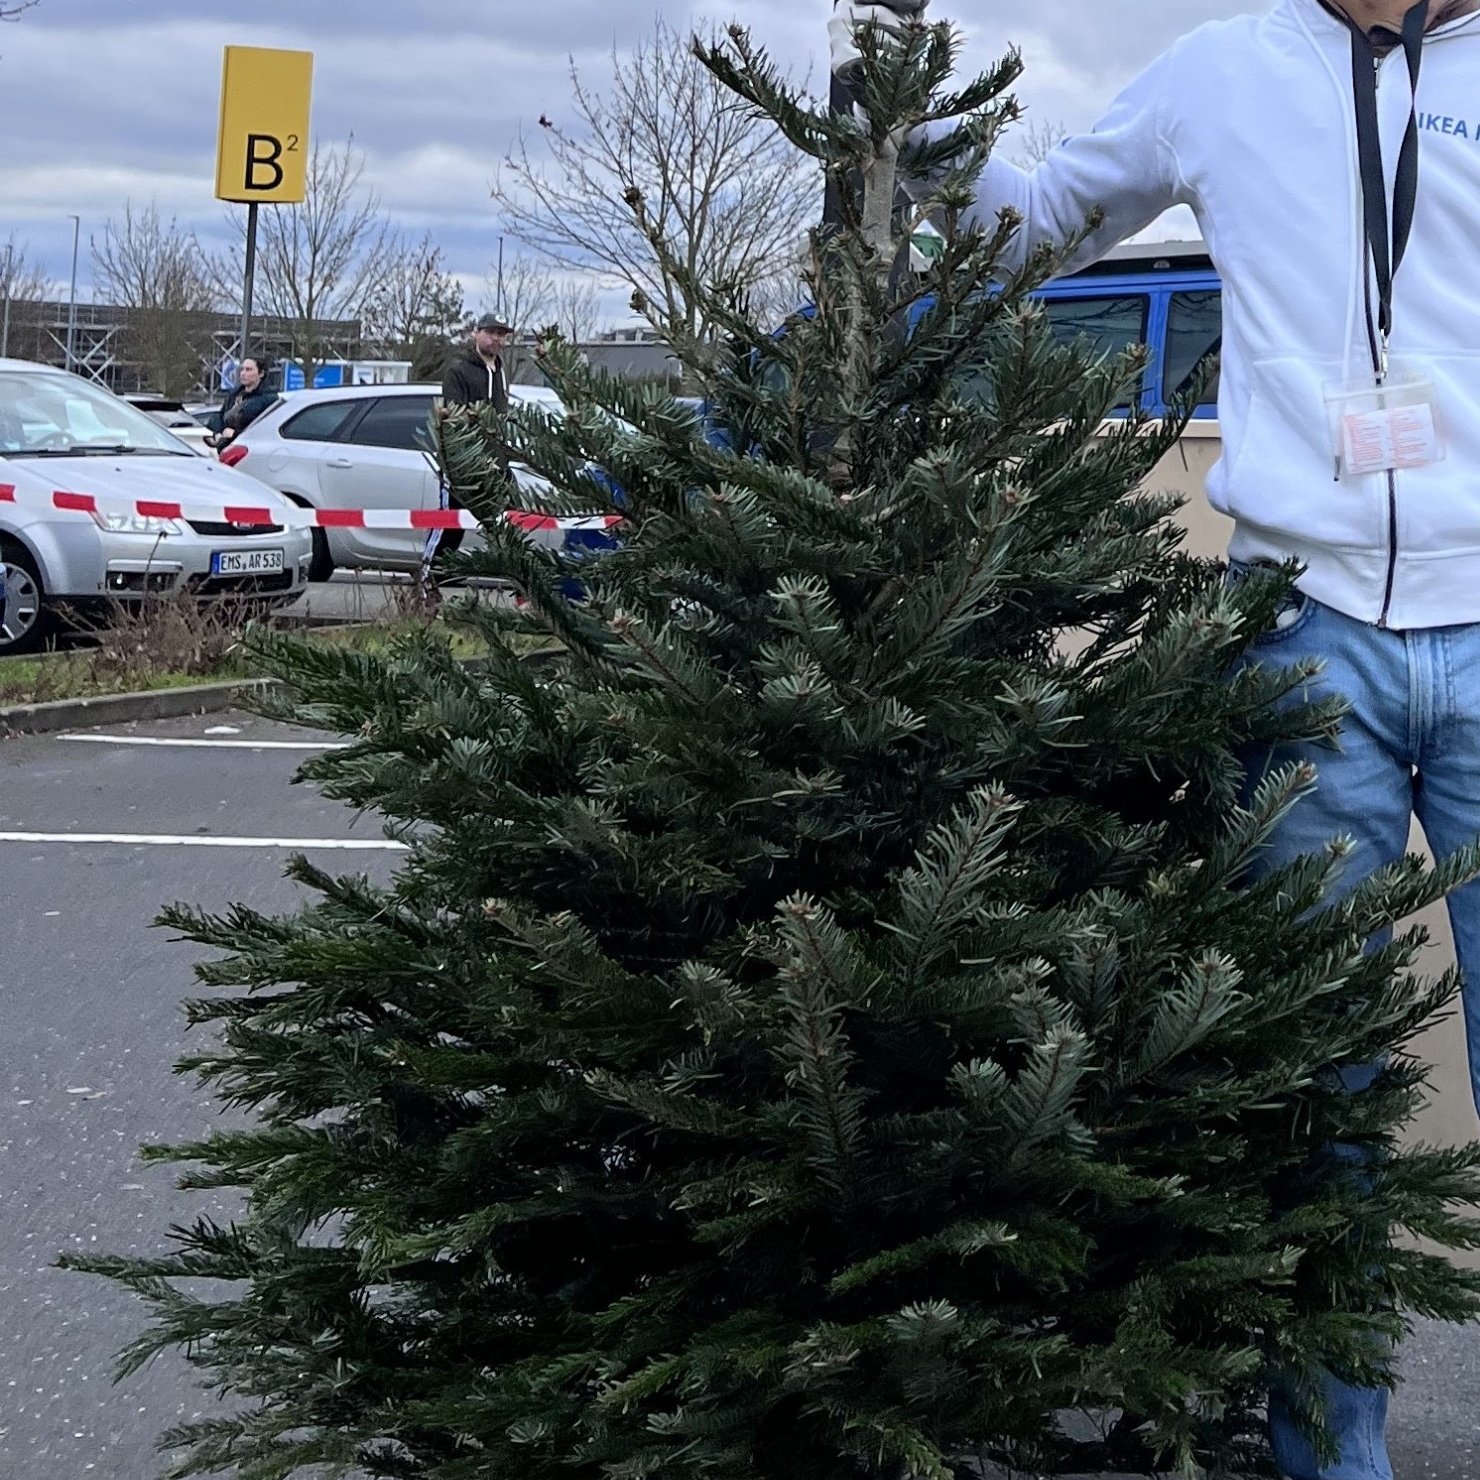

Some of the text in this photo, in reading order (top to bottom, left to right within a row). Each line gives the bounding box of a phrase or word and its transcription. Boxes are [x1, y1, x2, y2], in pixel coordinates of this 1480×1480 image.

[1418, 112, 1468, 139] IKEA
[221, 553, 281, 570] EMS AR 538
